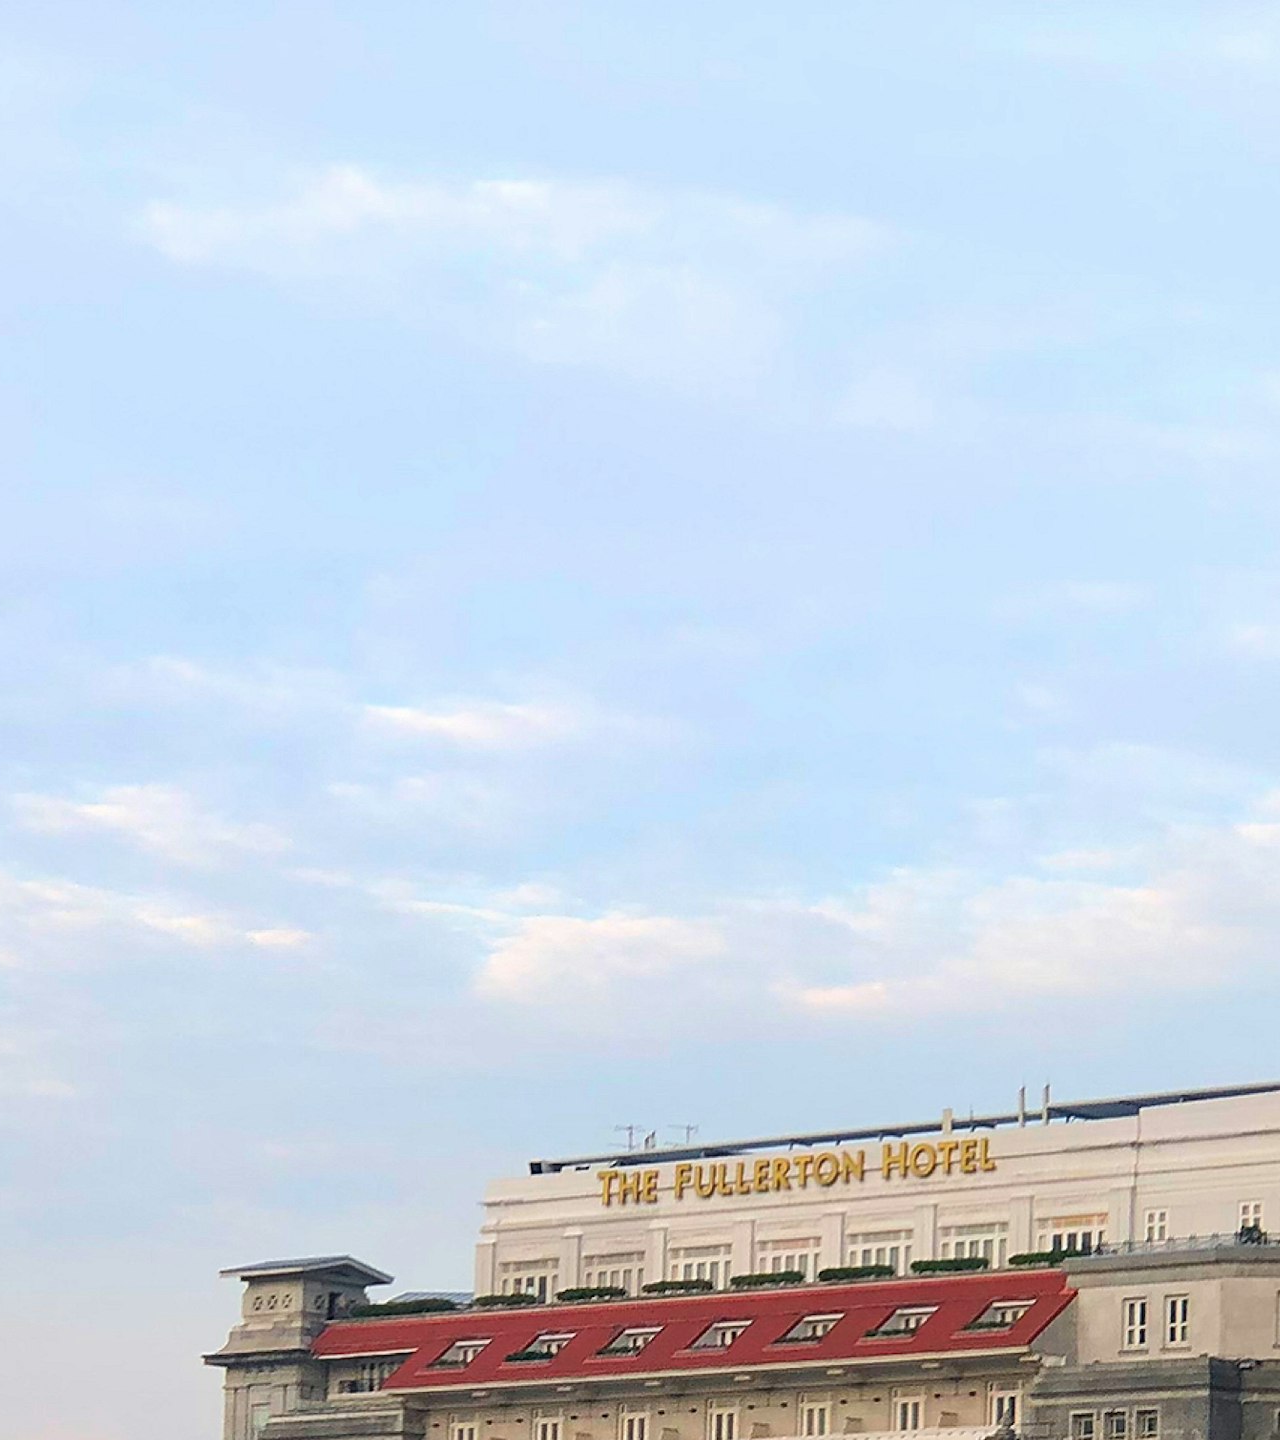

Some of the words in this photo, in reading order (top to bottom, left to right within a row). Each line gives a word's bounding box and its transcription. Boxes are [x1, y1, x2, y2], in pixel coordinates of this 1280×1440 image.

[596, 1169, 659, 1207] THE
[673, 1150, 865, 1198] FULLERTON
[881, 1136, 996, 1179] HOTEL
